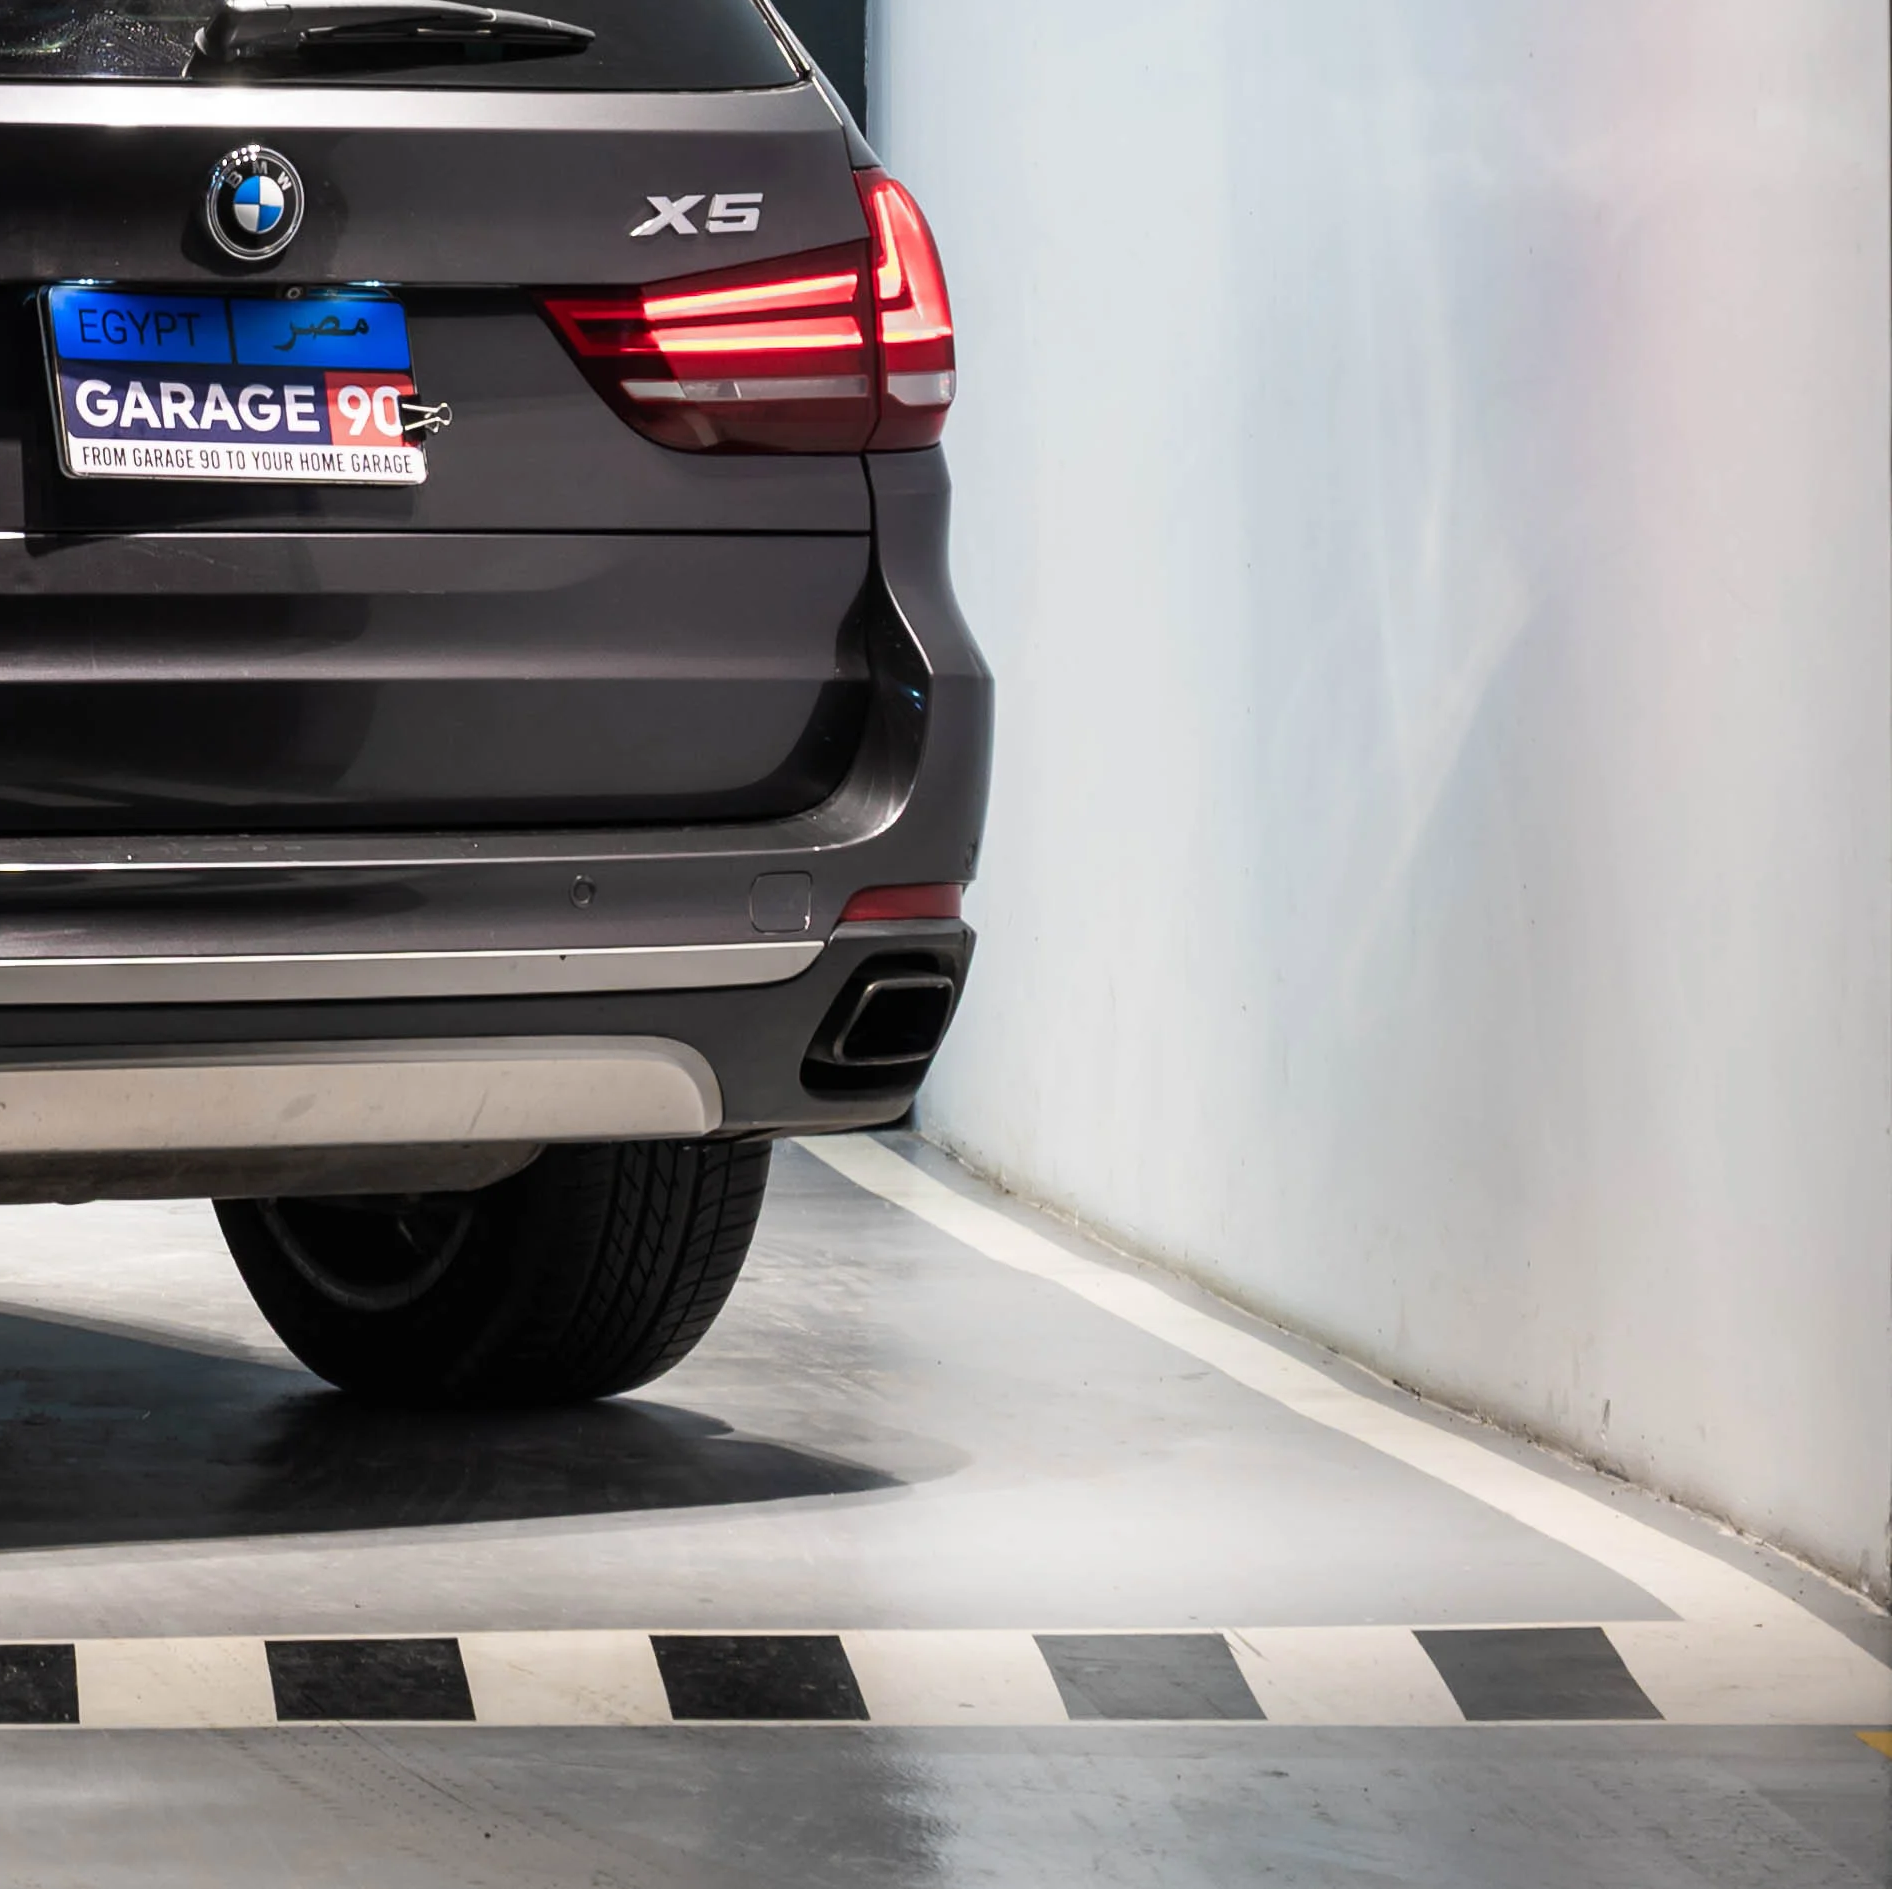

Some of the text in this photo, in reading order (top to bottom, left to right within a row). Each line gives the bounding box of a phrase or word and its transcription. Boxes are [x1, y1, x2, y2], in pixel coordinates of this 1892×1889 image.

[225, 160, 293, 192] BMW
[629, 192, 764, 237] X5
[78, 308, 201, 347] EGYPT
[272, 314, 370, 352] مصر
[74, 379, 404, 438] GARAGE 90
[82, 446, 413, 474] FROM GARAGE 90 TO YOUR HOME GARAGE
